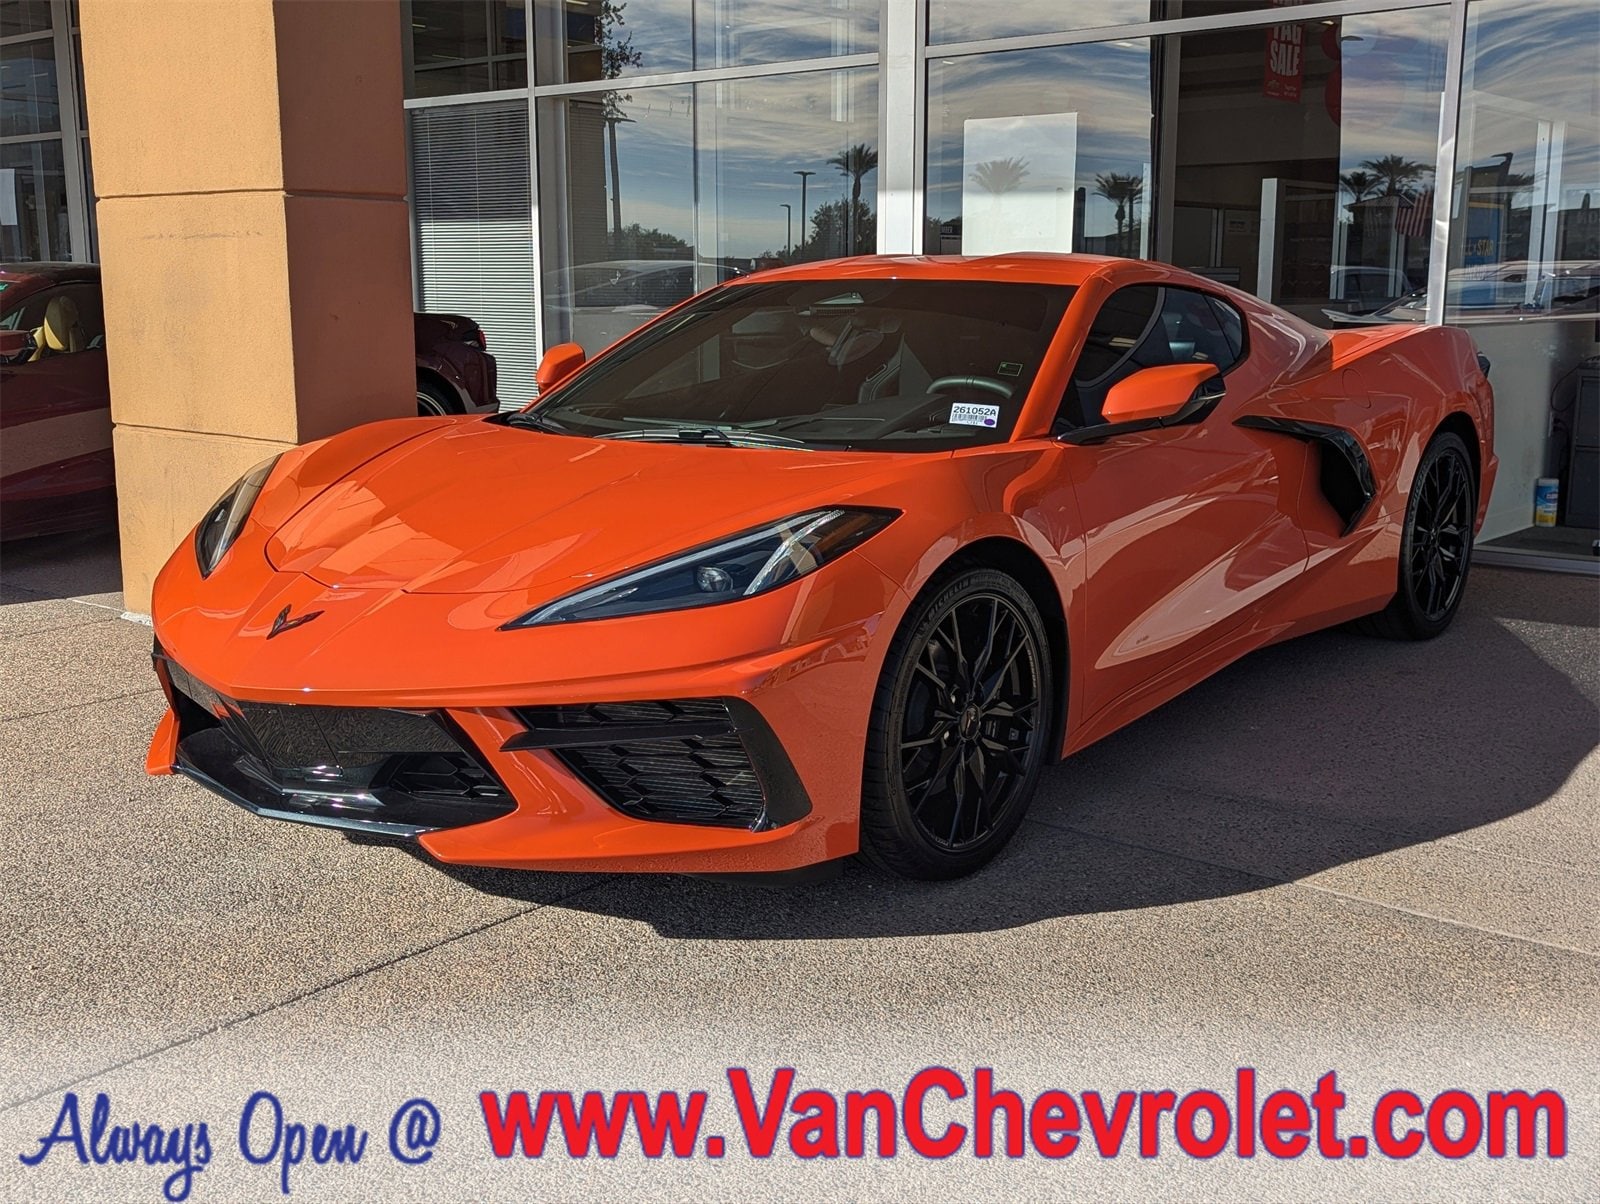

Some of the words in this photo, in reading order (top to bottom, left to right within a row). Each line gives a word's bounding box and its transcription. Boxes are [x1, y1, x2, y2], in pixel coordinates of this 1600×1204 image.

[1270, 39, 1300, 76] SALE
[1476, 239, 1494, 256] STAR
[953, 406, 996, 416] 261052A
[928, 578, 969, 621] MICHELIN
